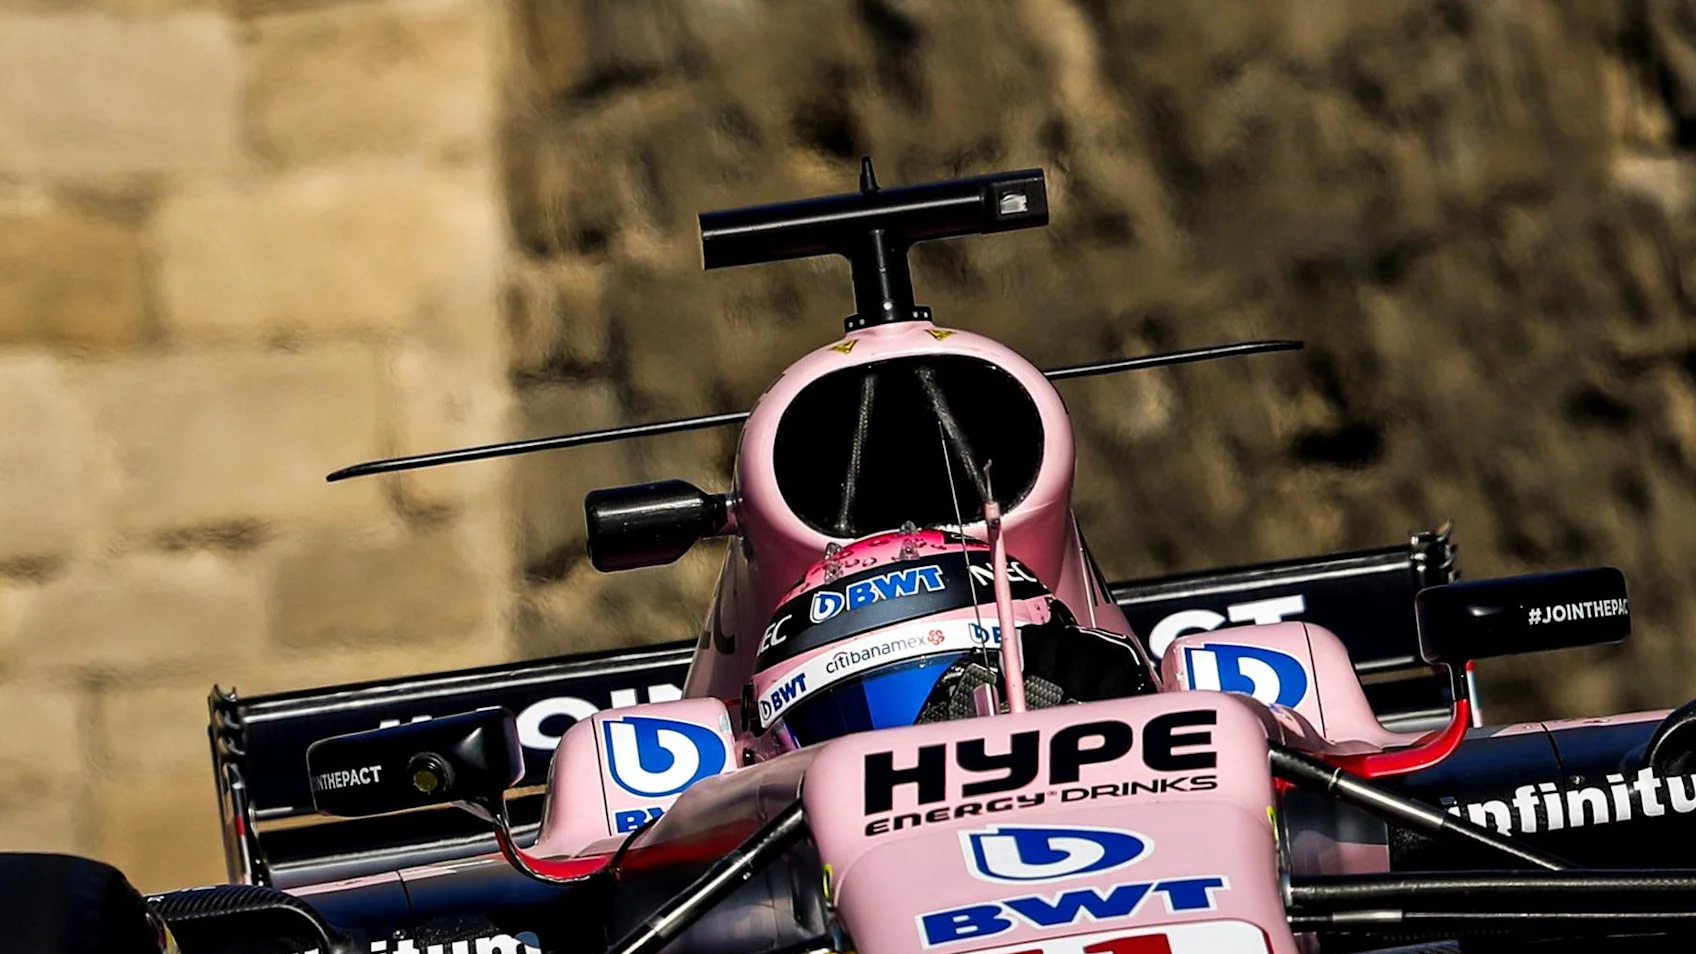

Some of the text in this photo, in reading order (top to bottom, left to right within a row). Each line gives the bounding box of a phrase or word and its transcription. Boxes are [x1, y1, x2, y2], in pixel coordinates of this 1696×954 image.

[847, 565, 945, 611] BWT
[825, 634, 926, 674] citibanamex
[771, 672, 807, 711] BWT
[864, 709, 1218, 817] HYPE
[1061, 775, 1218, 803] DRINKS
[921, 877, 1225, 946] BWT
